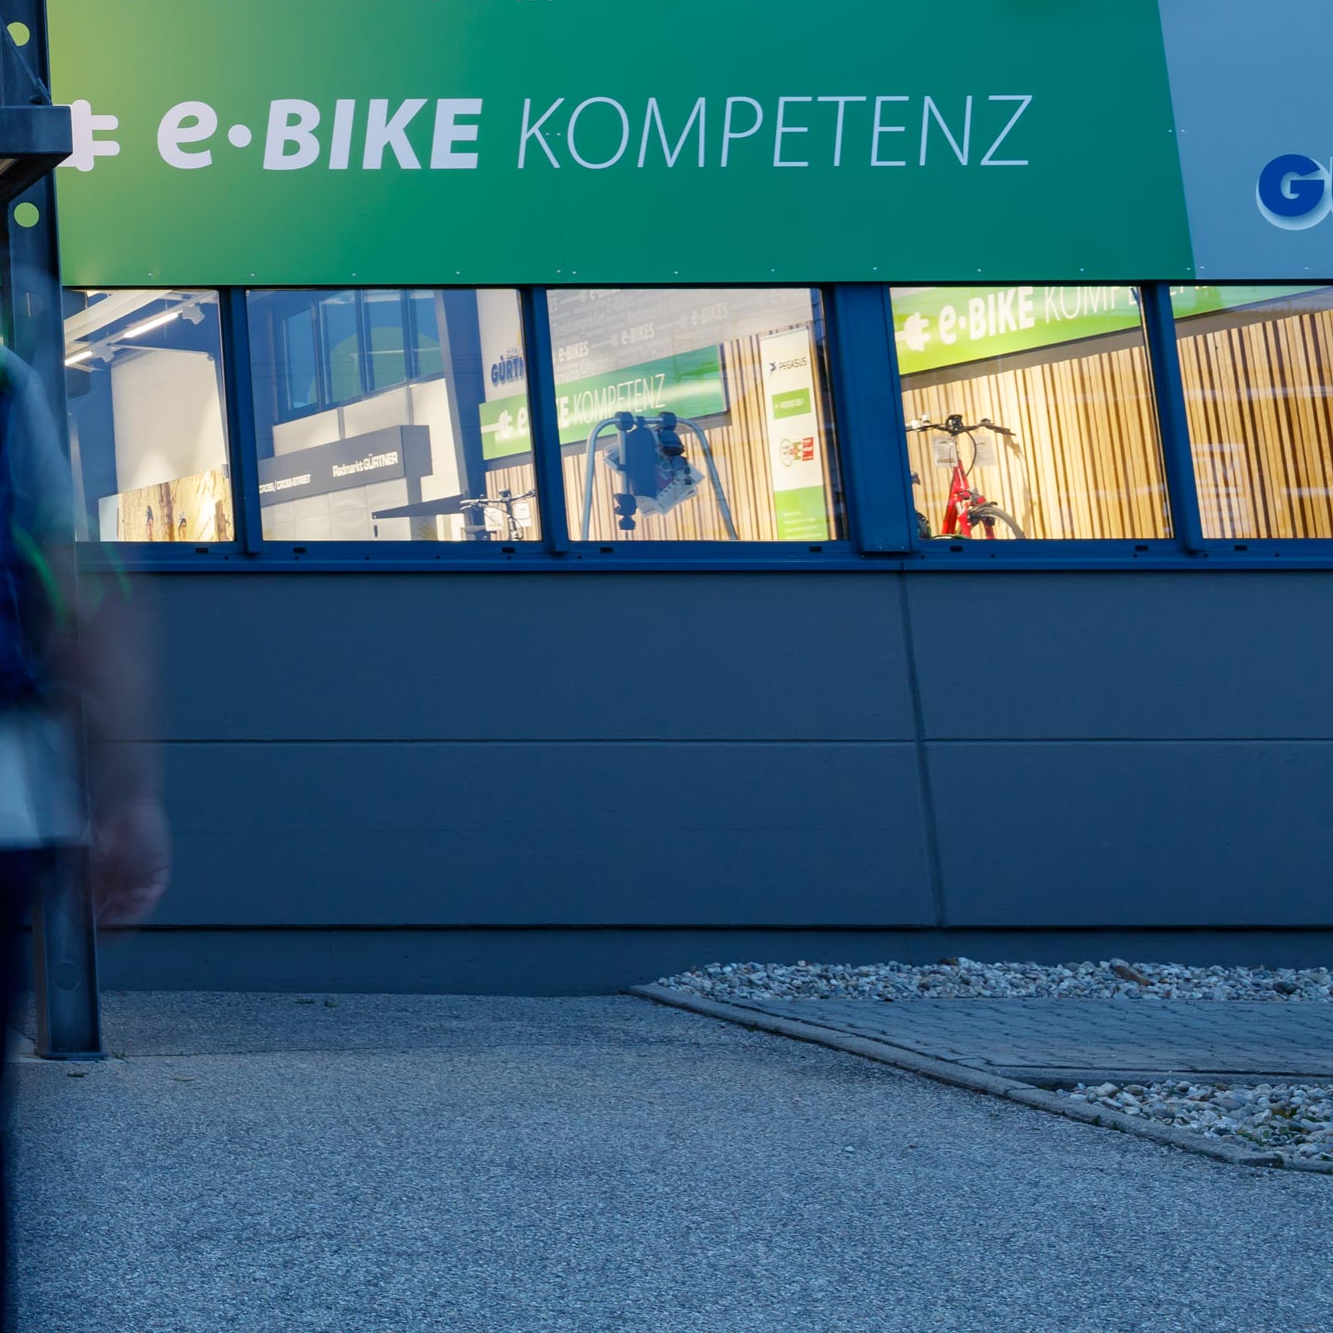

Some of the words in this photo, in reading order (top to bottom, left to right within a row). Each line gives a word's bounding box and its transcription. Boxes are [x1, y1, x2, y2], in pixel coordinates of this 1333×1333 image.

[517, 95, 1033, 169] KOMPETENZ
[1258, 154, 1333, 219] G
[778, 356, 807, 371] PEGASUS
[573, 373, 666, 425] KOMPETENZ
[332, 460, 364, 477] Radmarkt
[363, 451, 399, 471] GÜRTNER
